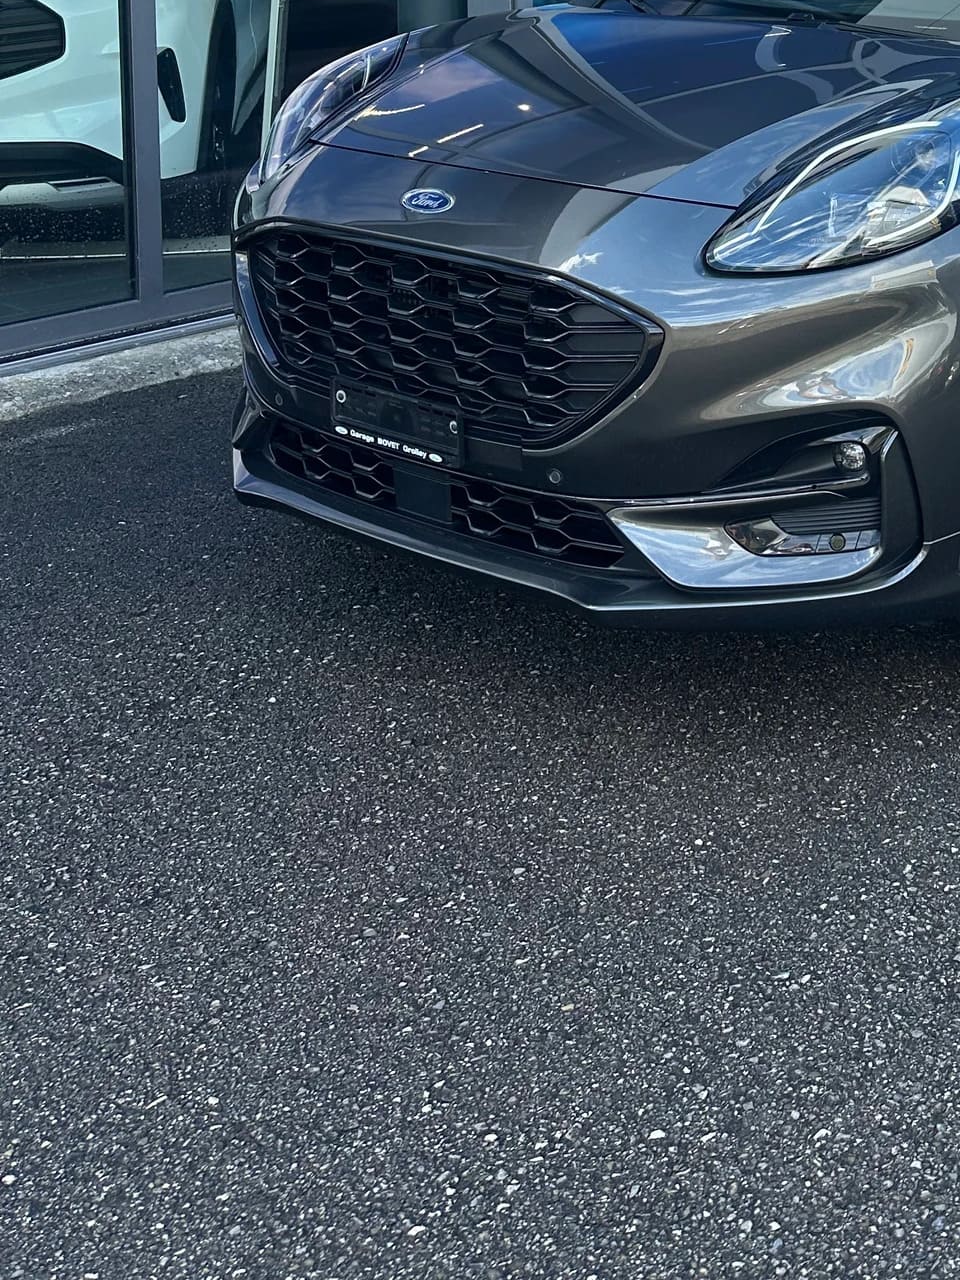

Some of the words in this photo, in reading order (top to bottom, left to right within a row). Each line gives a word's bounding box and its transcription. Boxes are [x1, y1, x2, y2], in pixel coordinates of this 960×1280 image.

[349, 428, 375, 443] Garage
[377, 437, 401, 450] BOVET
[402, 444, 427, 460] Grolley
